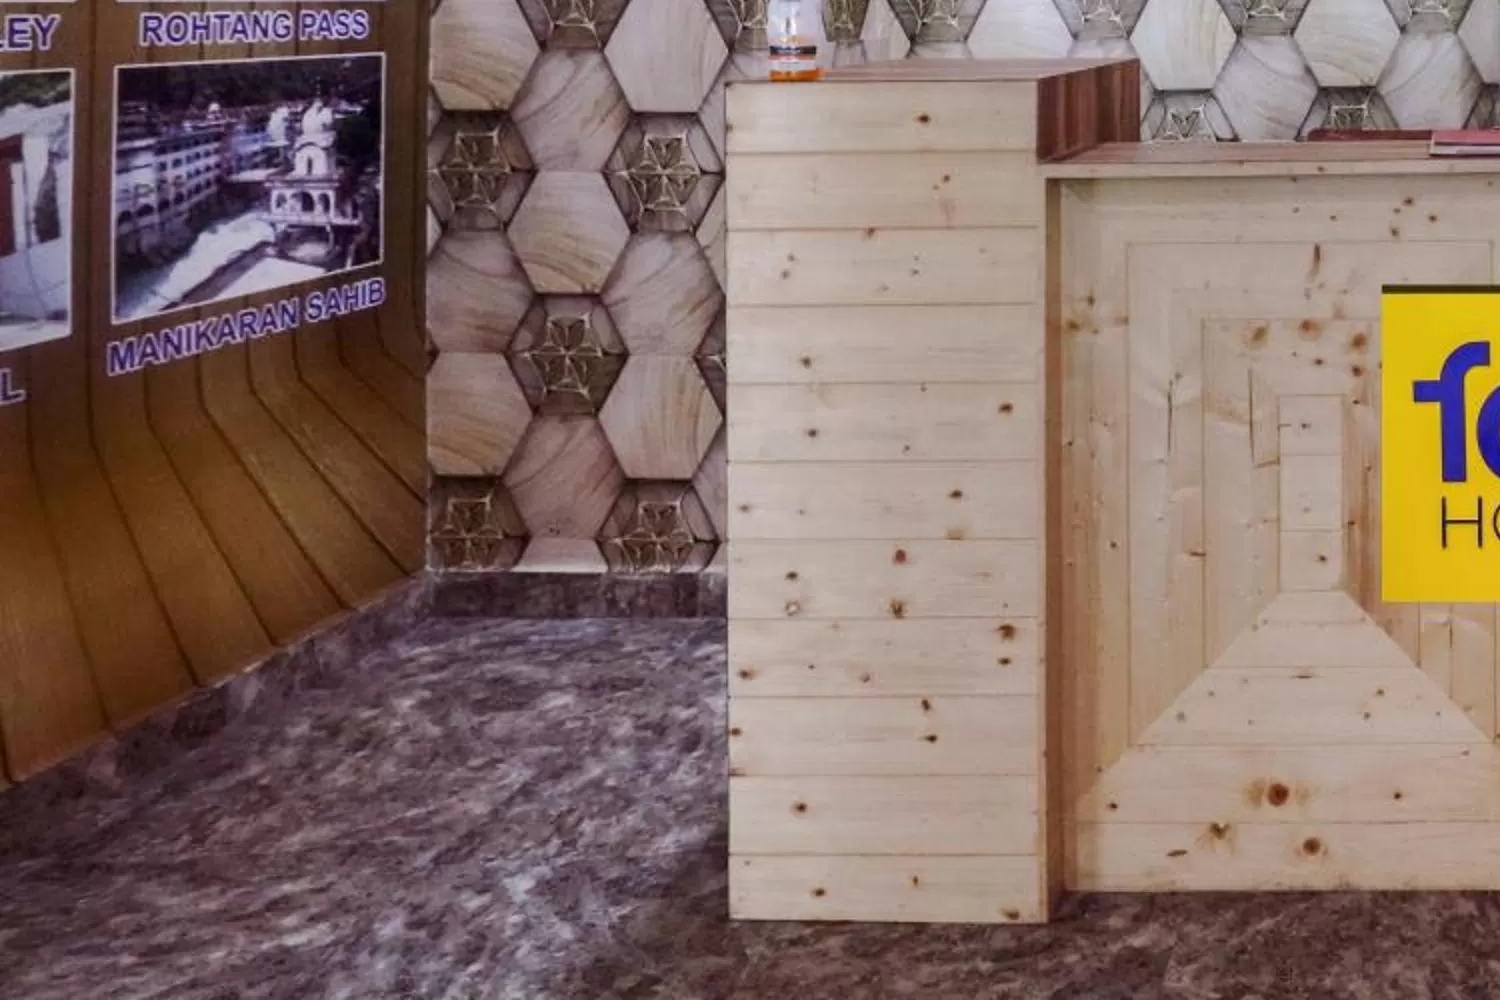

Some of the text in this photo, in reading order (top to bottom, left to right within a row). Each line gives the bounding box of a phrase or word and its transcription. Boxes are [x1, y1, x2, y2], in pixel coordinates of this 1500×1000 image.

[140, 10, 369, 46] ROHTANG PASS
[107, 278, 386, 376] MANIKARAN SAHIB
